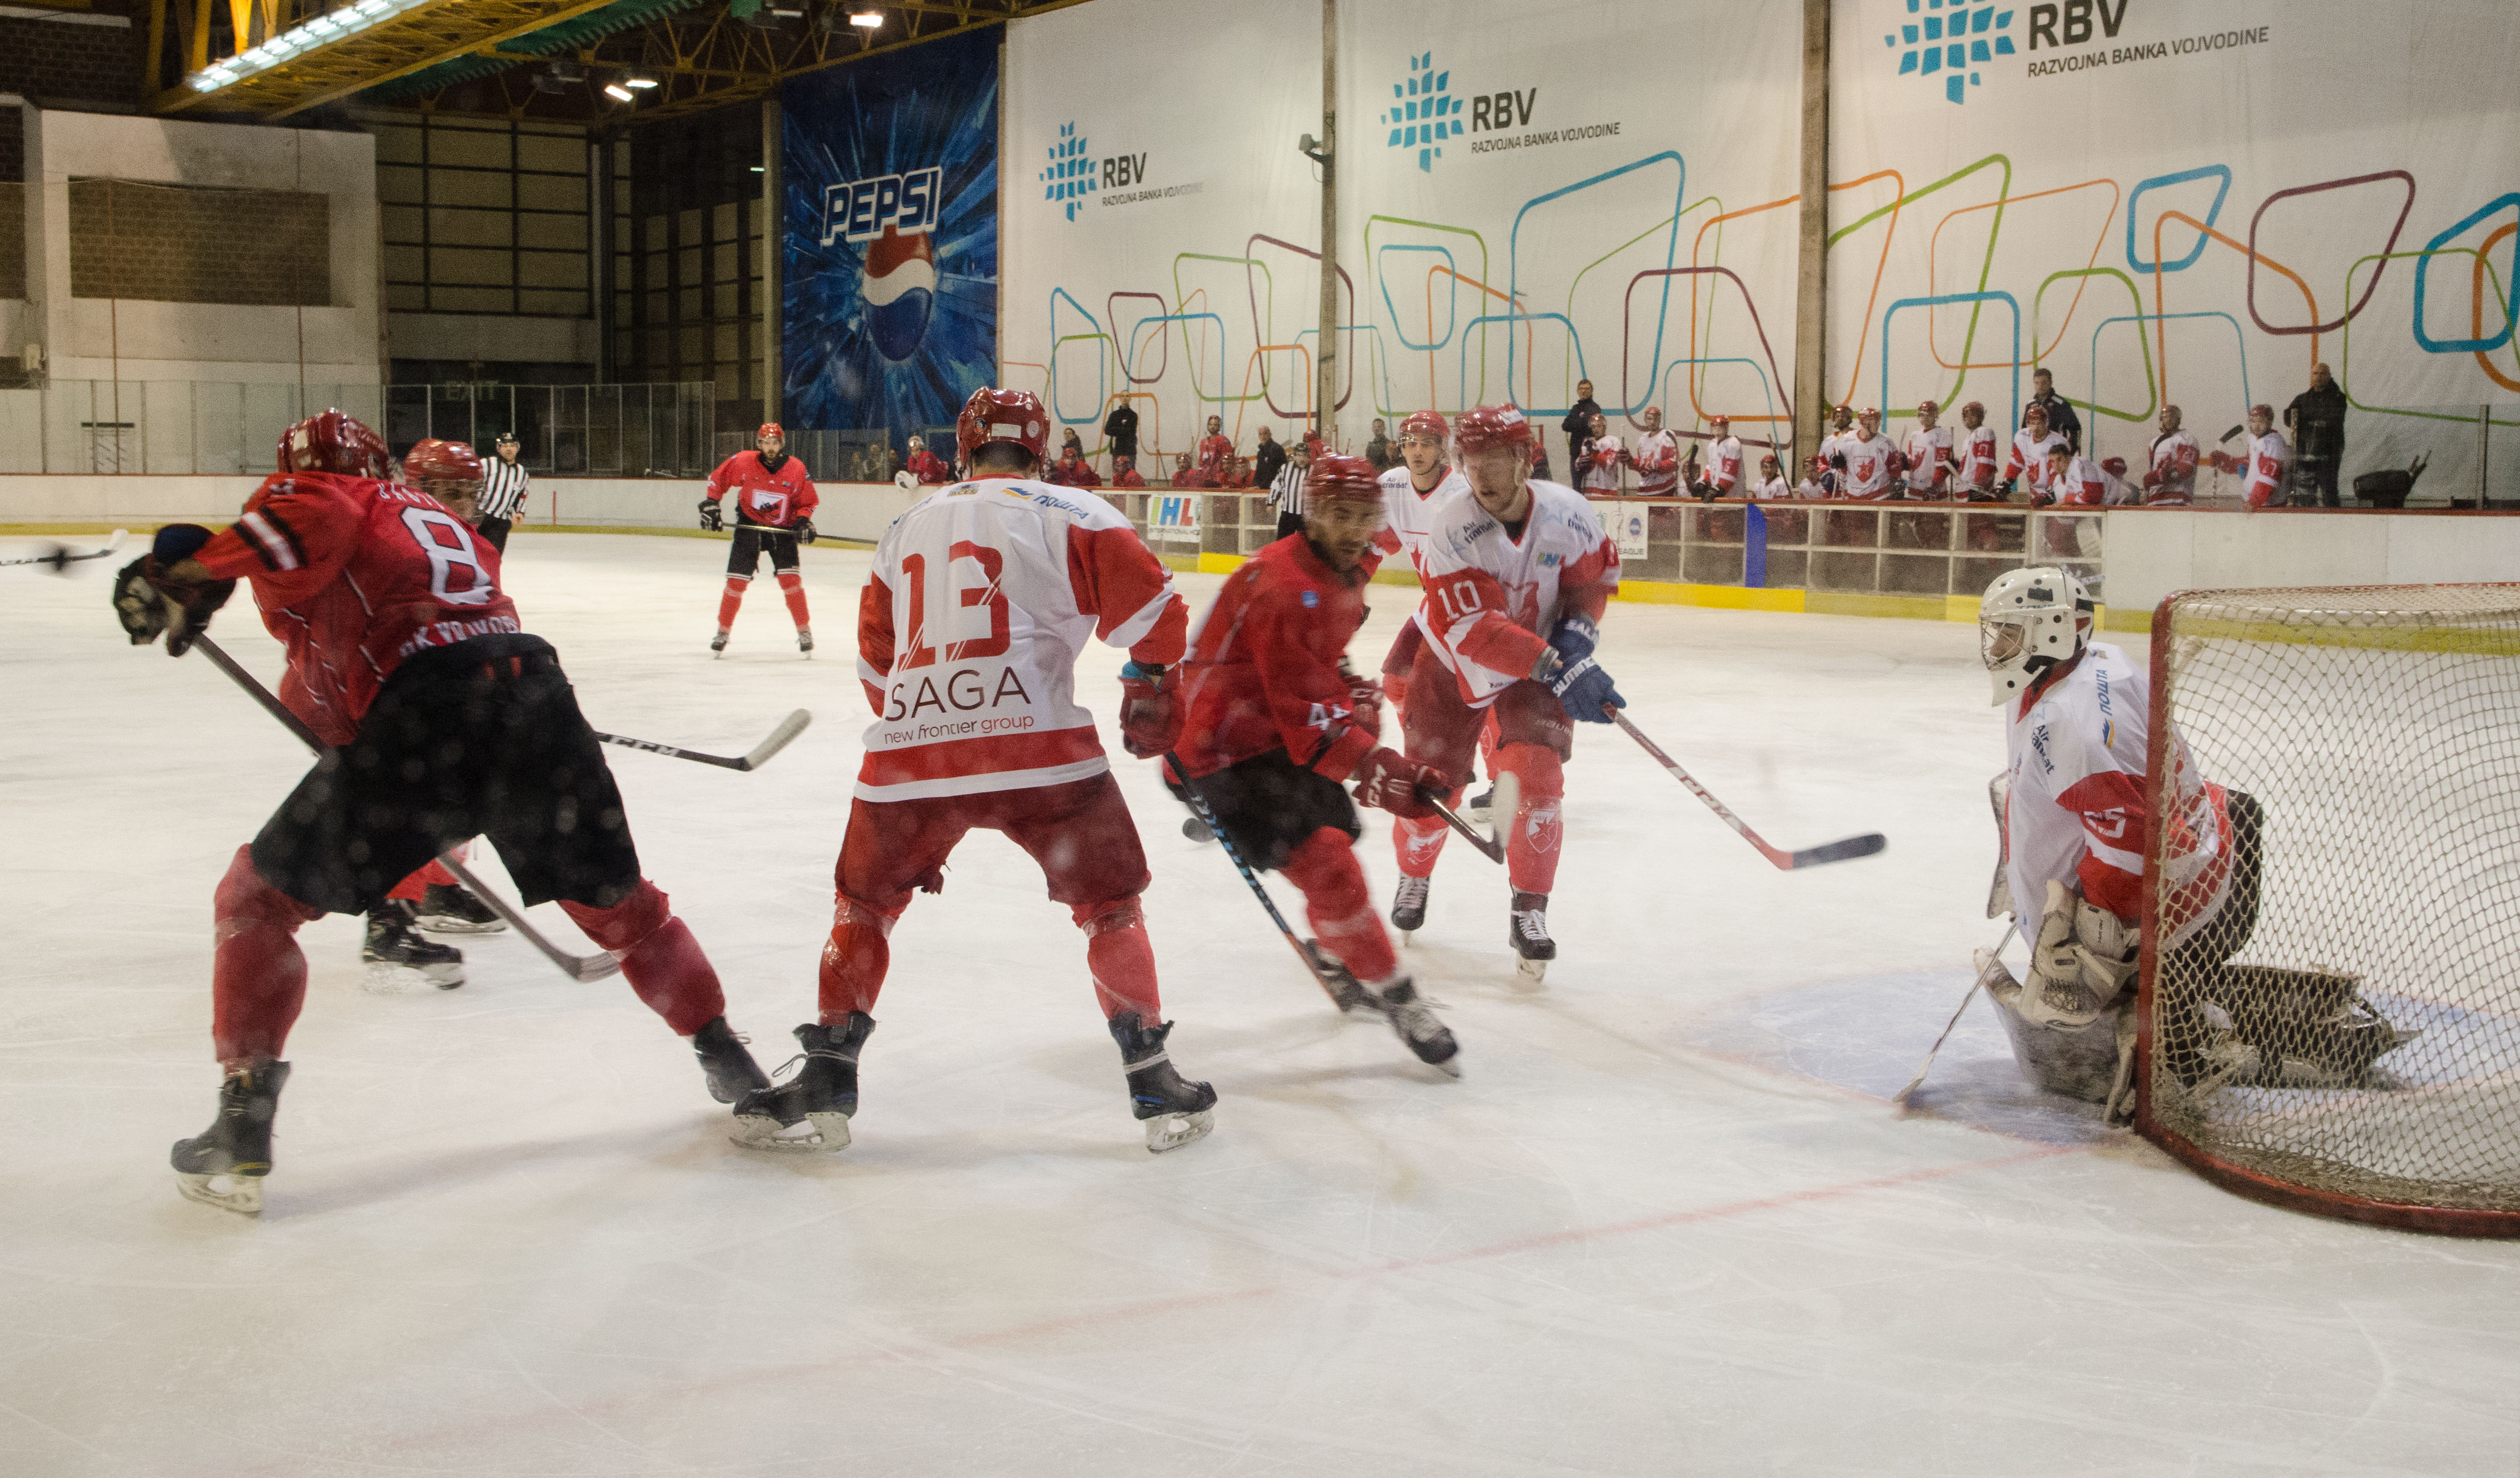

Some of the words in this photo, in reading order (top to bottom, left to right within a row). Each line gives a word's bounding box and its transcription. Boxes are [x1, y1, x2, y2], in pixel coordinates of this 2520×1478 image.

[2029, 0, 2129, 51] RBV
[2028, 52, 2108, 77] RAZVOJNA
[2112, 42, 2168, 65] BANKA
[2171, 26, 2269, 54] VOJVODINE
[1472, 88, 1537, 132] RBV
[1471, 136, 1522, 154] RAZVOJNA
[1524, 131, 1559, 147] BANKA
[1561, 122, 1620, 141] VOJVODINE
[1103, 152, 1147, 188] RBV
[820, 166, 942, 246] PEPSI
[1102, 192, 1137, 206] RAZVOJNA
[1139, 188, 1162, 201] BANKA
[1150, 497, 1194, 526] IHL
[399, 505, 494, 604] 8
[897, 539, 1011, 673] 13
[1438, 579, 1483, 622] 10
[885, 666, 1031, 721] SAGA
[2096, 669, 2112, 717] ПОШТА
[885, 729, 914, 744] new
[918, 720, 977, 740] frontier
[981, 716, 1034, 733] group
[2036, 725, 2049, 742] Air
